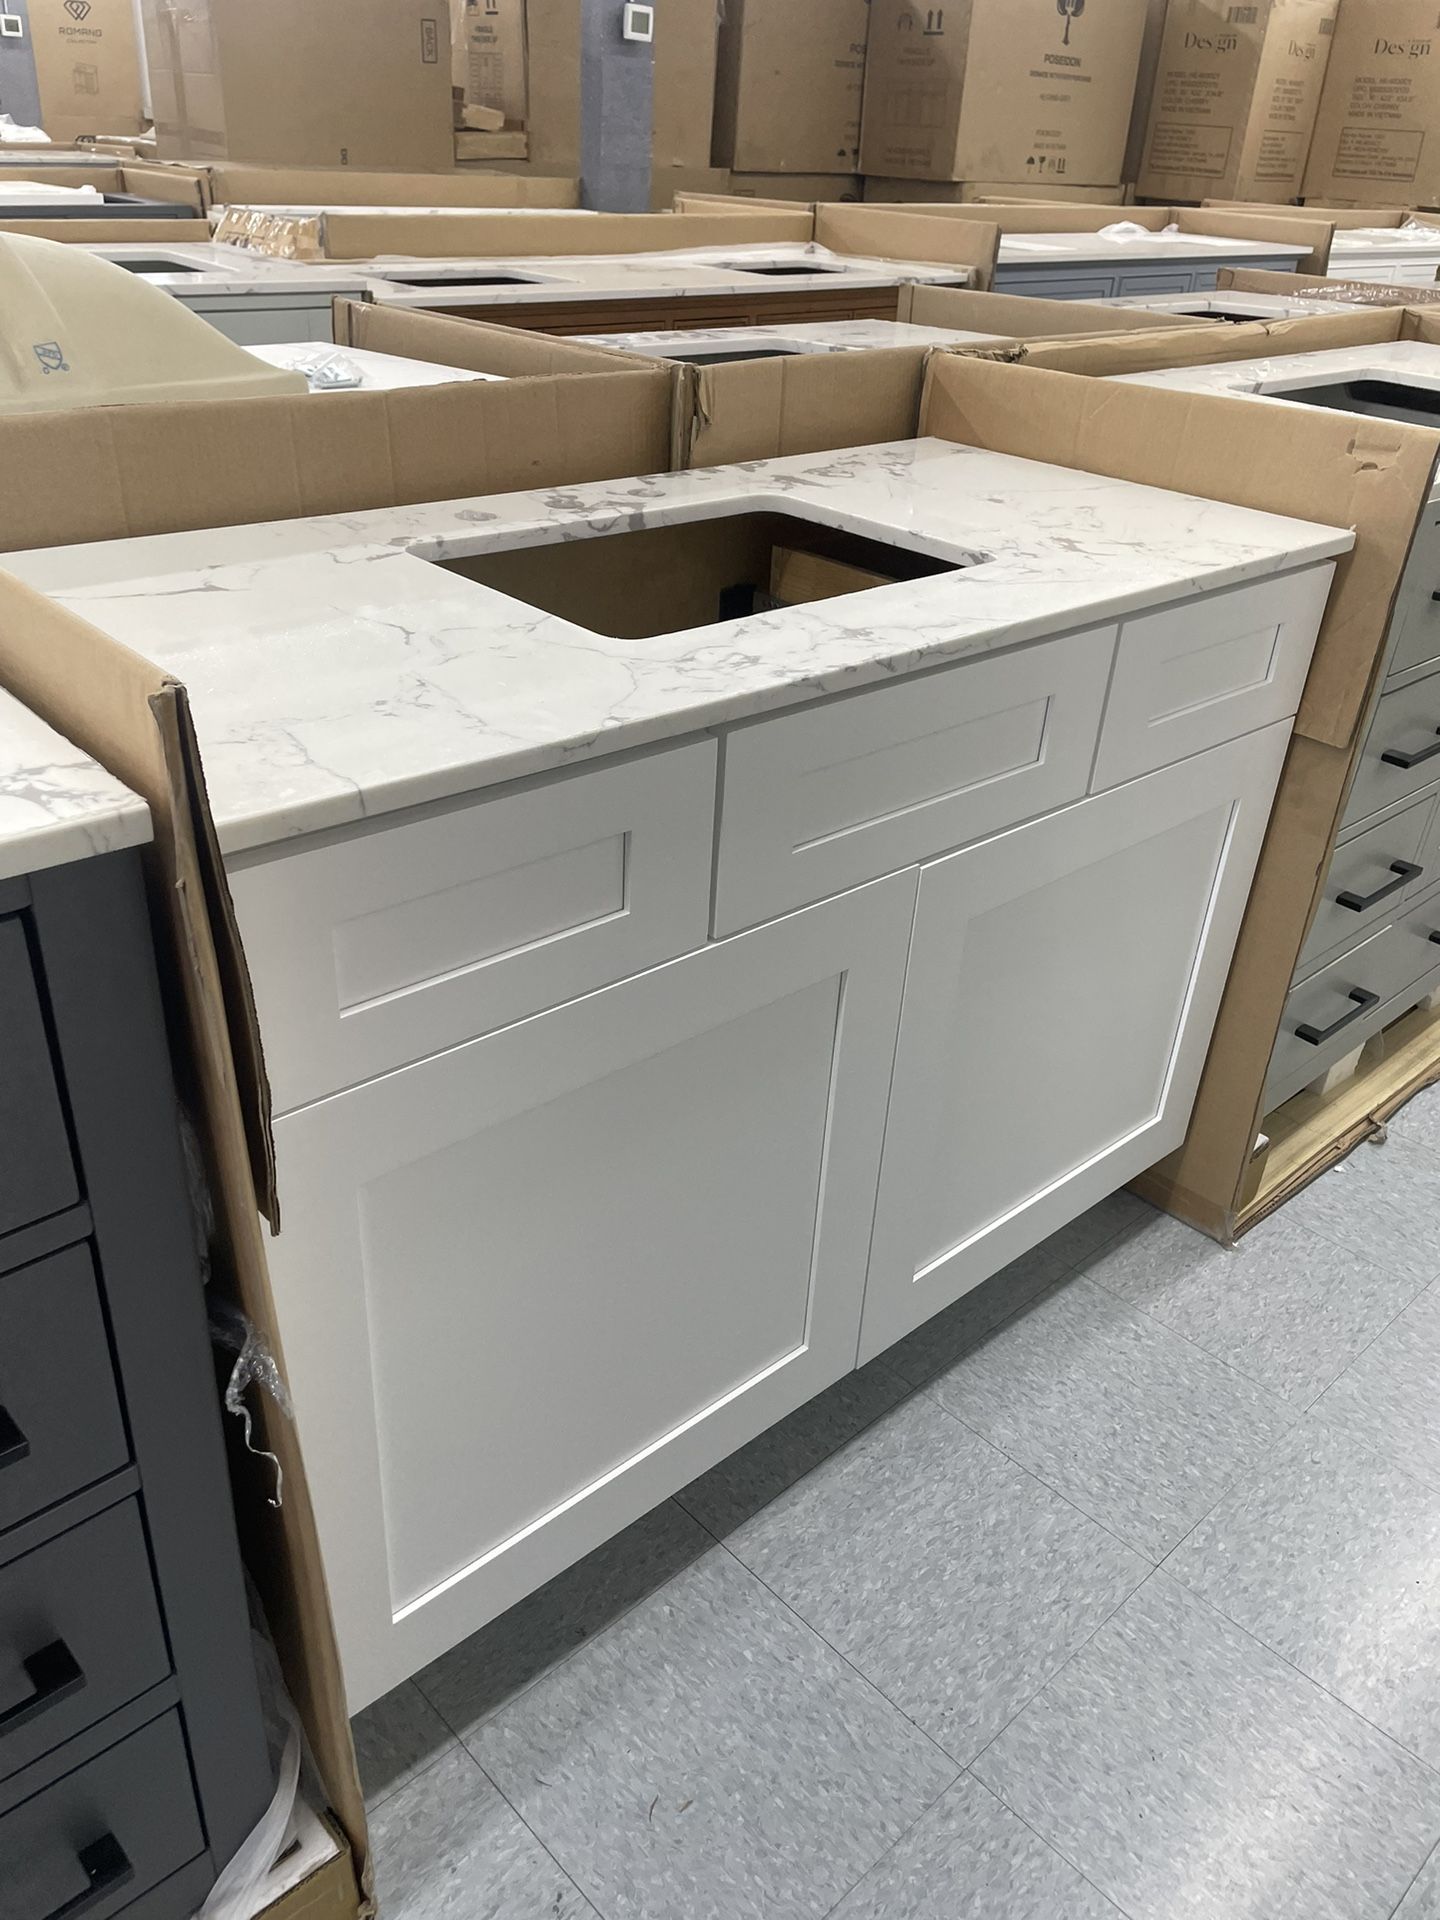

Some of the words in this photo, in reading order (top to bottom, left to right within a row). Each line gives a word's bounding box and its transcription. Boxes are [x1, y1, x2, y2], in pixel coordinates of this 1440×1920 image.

[58, 26, 103, 38] ROMANO
[425, 27, 433, 56] BACK
[1184, 32, 1237, 53] Desgn
[1374, 39, 1431, 59] Desgn
[1044, 53, 1082, 67] POSEIDON
